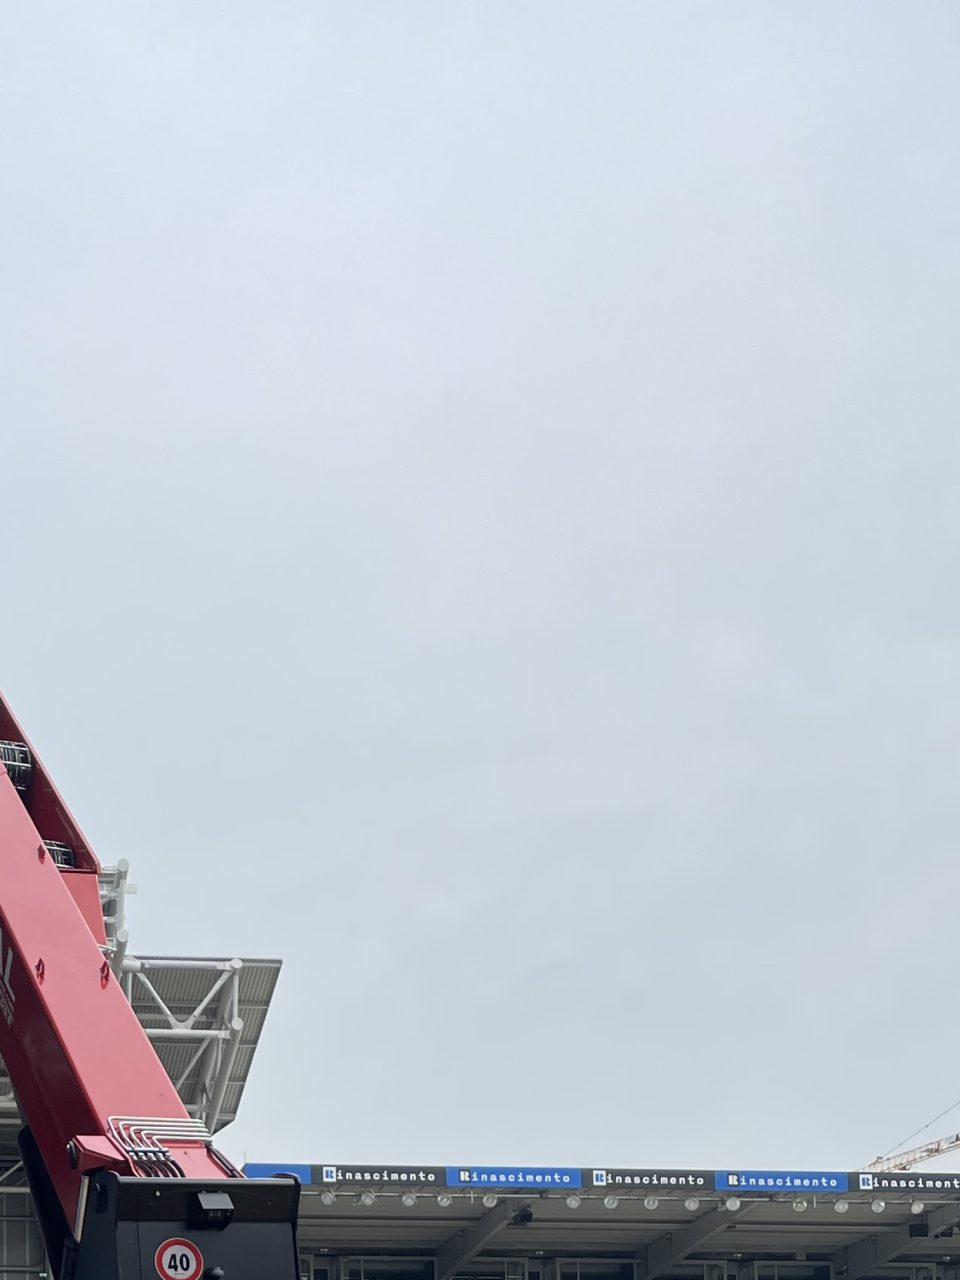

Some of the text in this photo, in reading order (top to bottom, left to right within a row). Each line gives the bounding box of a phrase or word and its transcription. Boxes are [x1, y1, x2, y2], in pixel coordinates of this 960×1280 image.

[323, 1167, 436, 1182] Rinascimento
[459, 1169, 571, 1184] Rinascimento
[593, 1171, 705, 1186] Rinascimento
[727, 1173, 838, 1188] Rinascimento
[167, 1253, 190, 1272] 40
